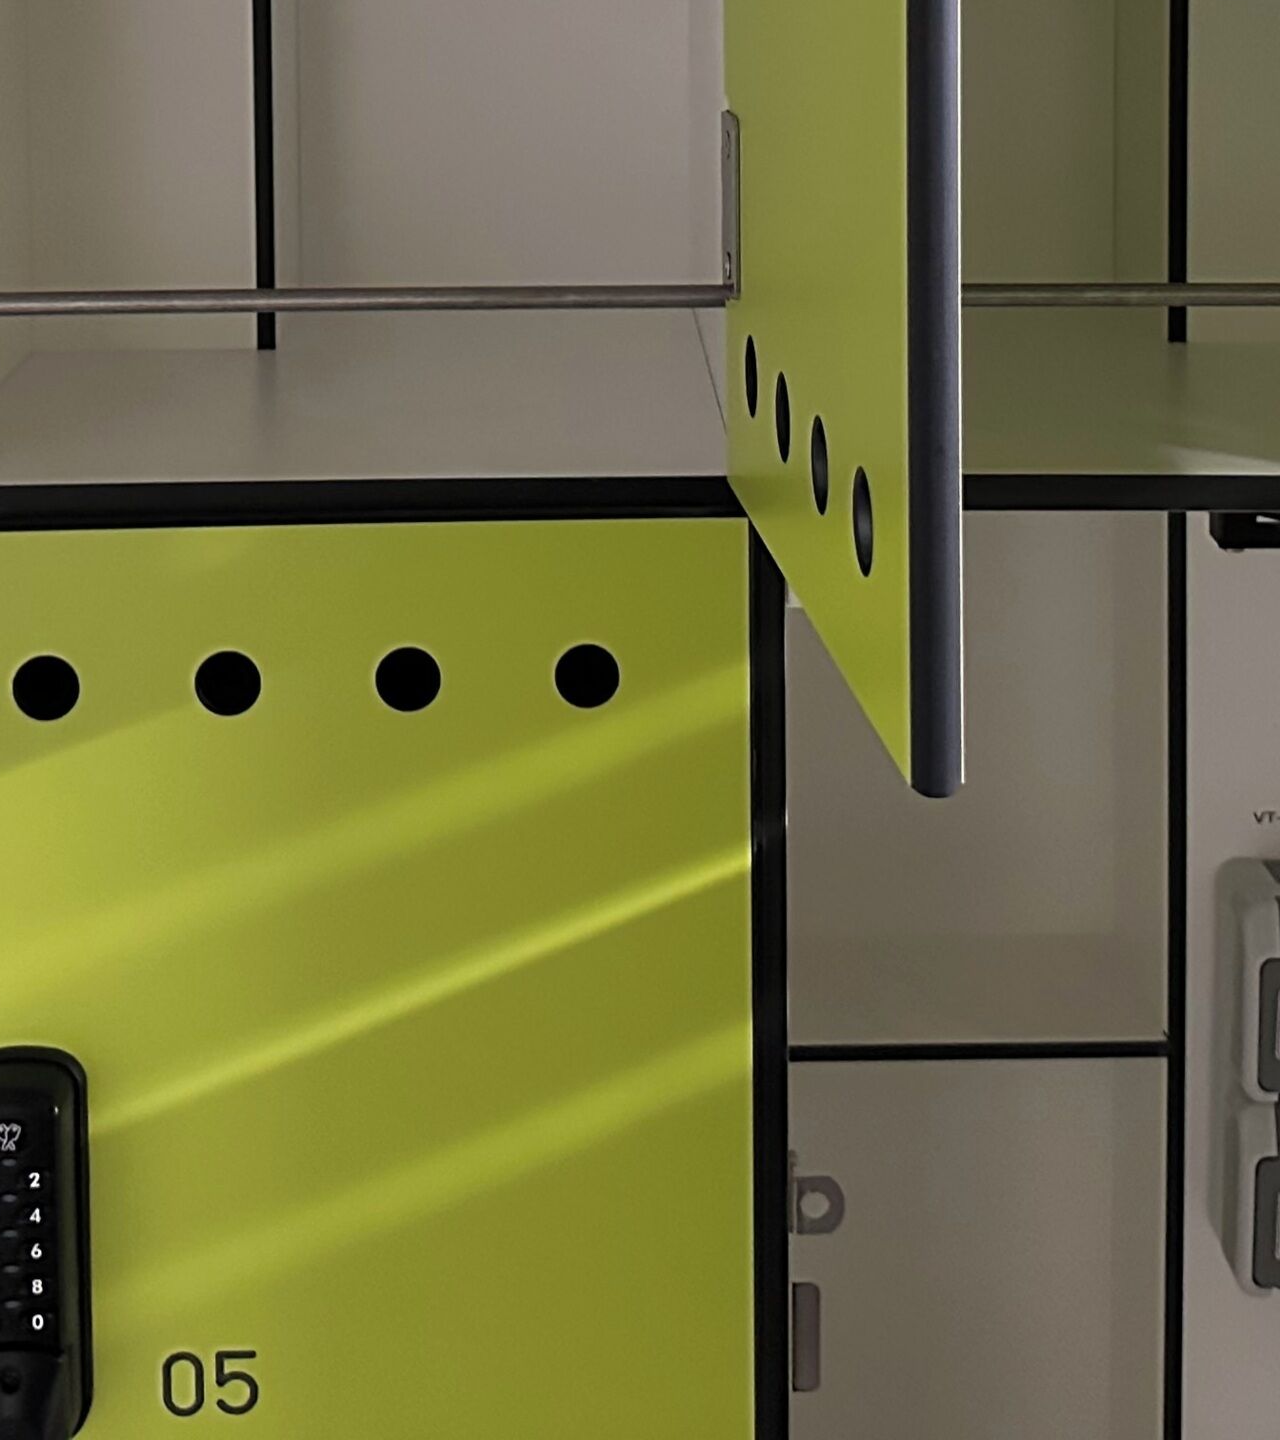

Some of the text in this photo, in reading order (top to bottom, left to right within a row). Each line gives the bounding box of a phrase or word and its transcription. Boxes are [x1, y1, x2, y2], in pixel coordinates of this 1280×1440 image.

[28, 1172, 41, 1189] 2
[29, 1207, 42, 1224] 4
[30, 1242, 43, 1259] 6
[31, 1278, 44, 1295] 8
[31, 1313, 44, 1331] 0
[161, 1349, 259, 1417] 05
